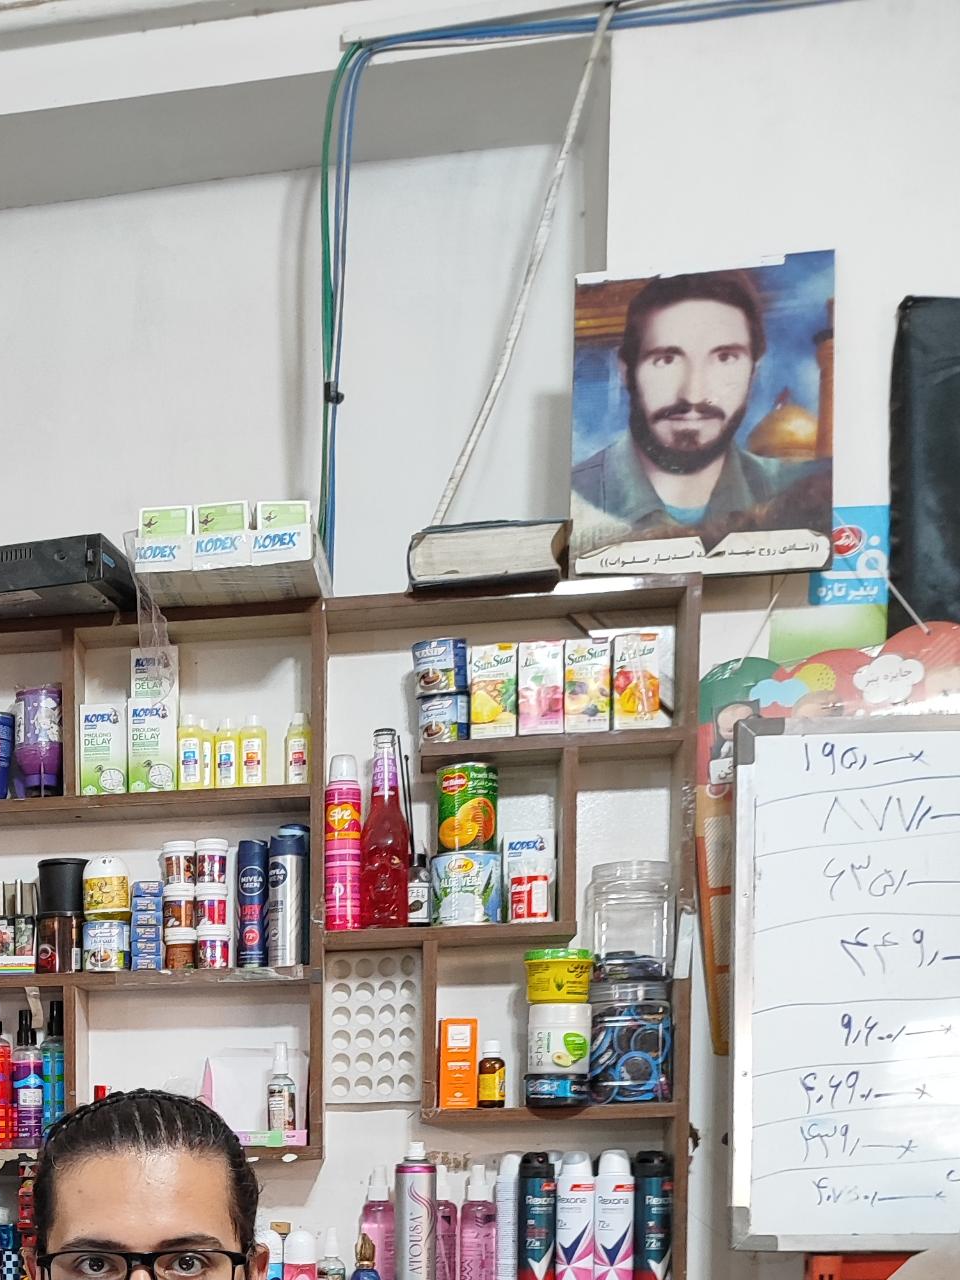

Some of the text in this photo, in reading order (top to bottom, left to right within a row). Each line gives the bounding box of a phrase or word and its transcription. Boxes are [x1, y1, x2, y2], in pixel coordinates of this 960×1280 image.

[195, 535, 238, 553] KODEX
[252, 533, 297, 549] KODEX
[135, 545, 177, 560] KODEX
[816, 582, 880, 602] پنیر تازه
[84, 713, 112, 724] KODEX
[132, 707, 161, 718] KODEX
[84, 738, 112, 746] DELAY
[132, 733, 161, 741] DELAY
[508, 839, 538, 852] KODEX
[241, 876, 263, 884] NIVEA
[598, 1196, 630, 1205] Rexona
[407, 1219, 423, 1275] ATOUSA
